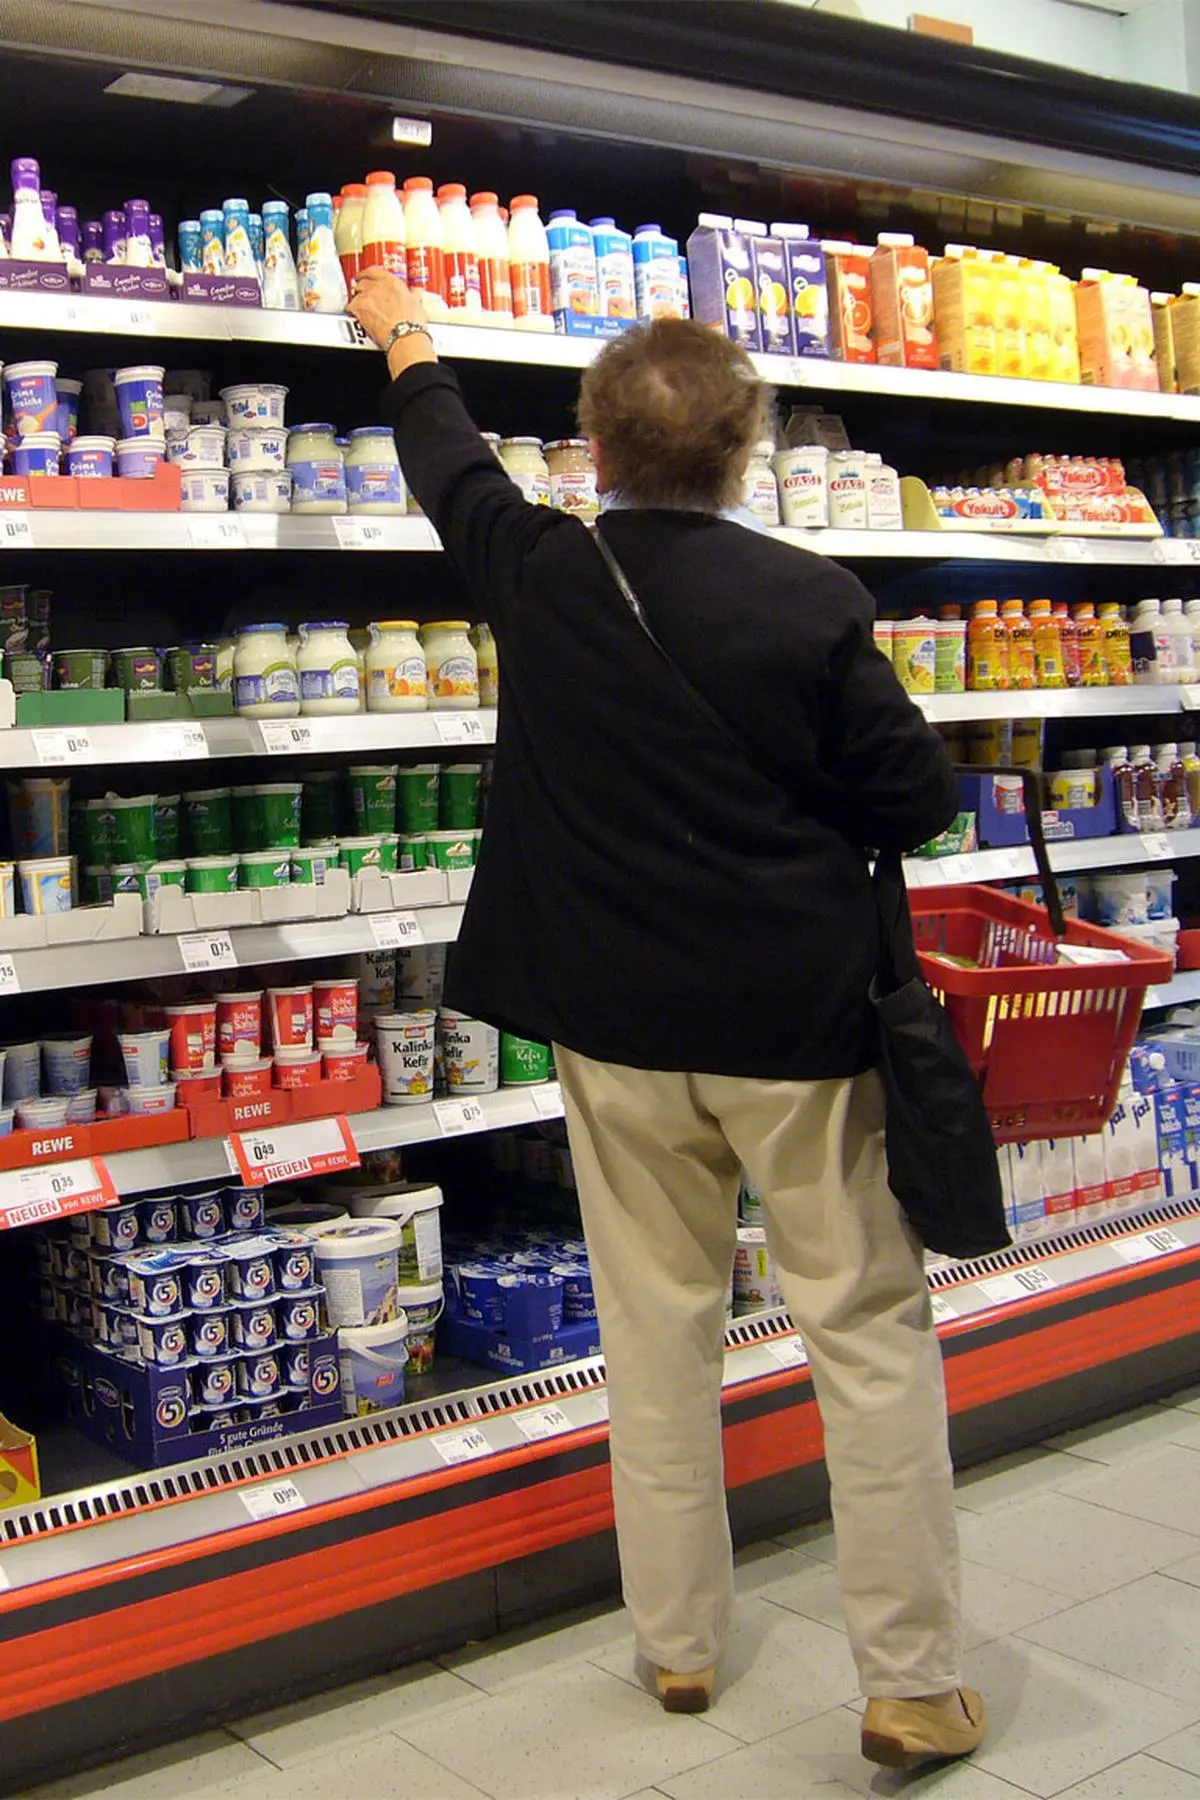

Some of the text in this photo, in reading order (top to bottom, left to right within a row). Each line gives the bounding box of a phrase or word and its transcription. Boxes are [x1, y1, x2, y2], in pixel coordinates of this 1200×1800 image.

[965, 503, 1008, 516] Yakult
[402, 1055, 429, 1069] Kefir
[235, 1102, 272, 1120] REWE
[32, 1136, 73, 1156] REWE
[267, 1158, 309, 1180] NEUEN
[9, 1200, 58, 1224] NEUEN
[219, 1421, 284, 1448] 5 gute Gründe
